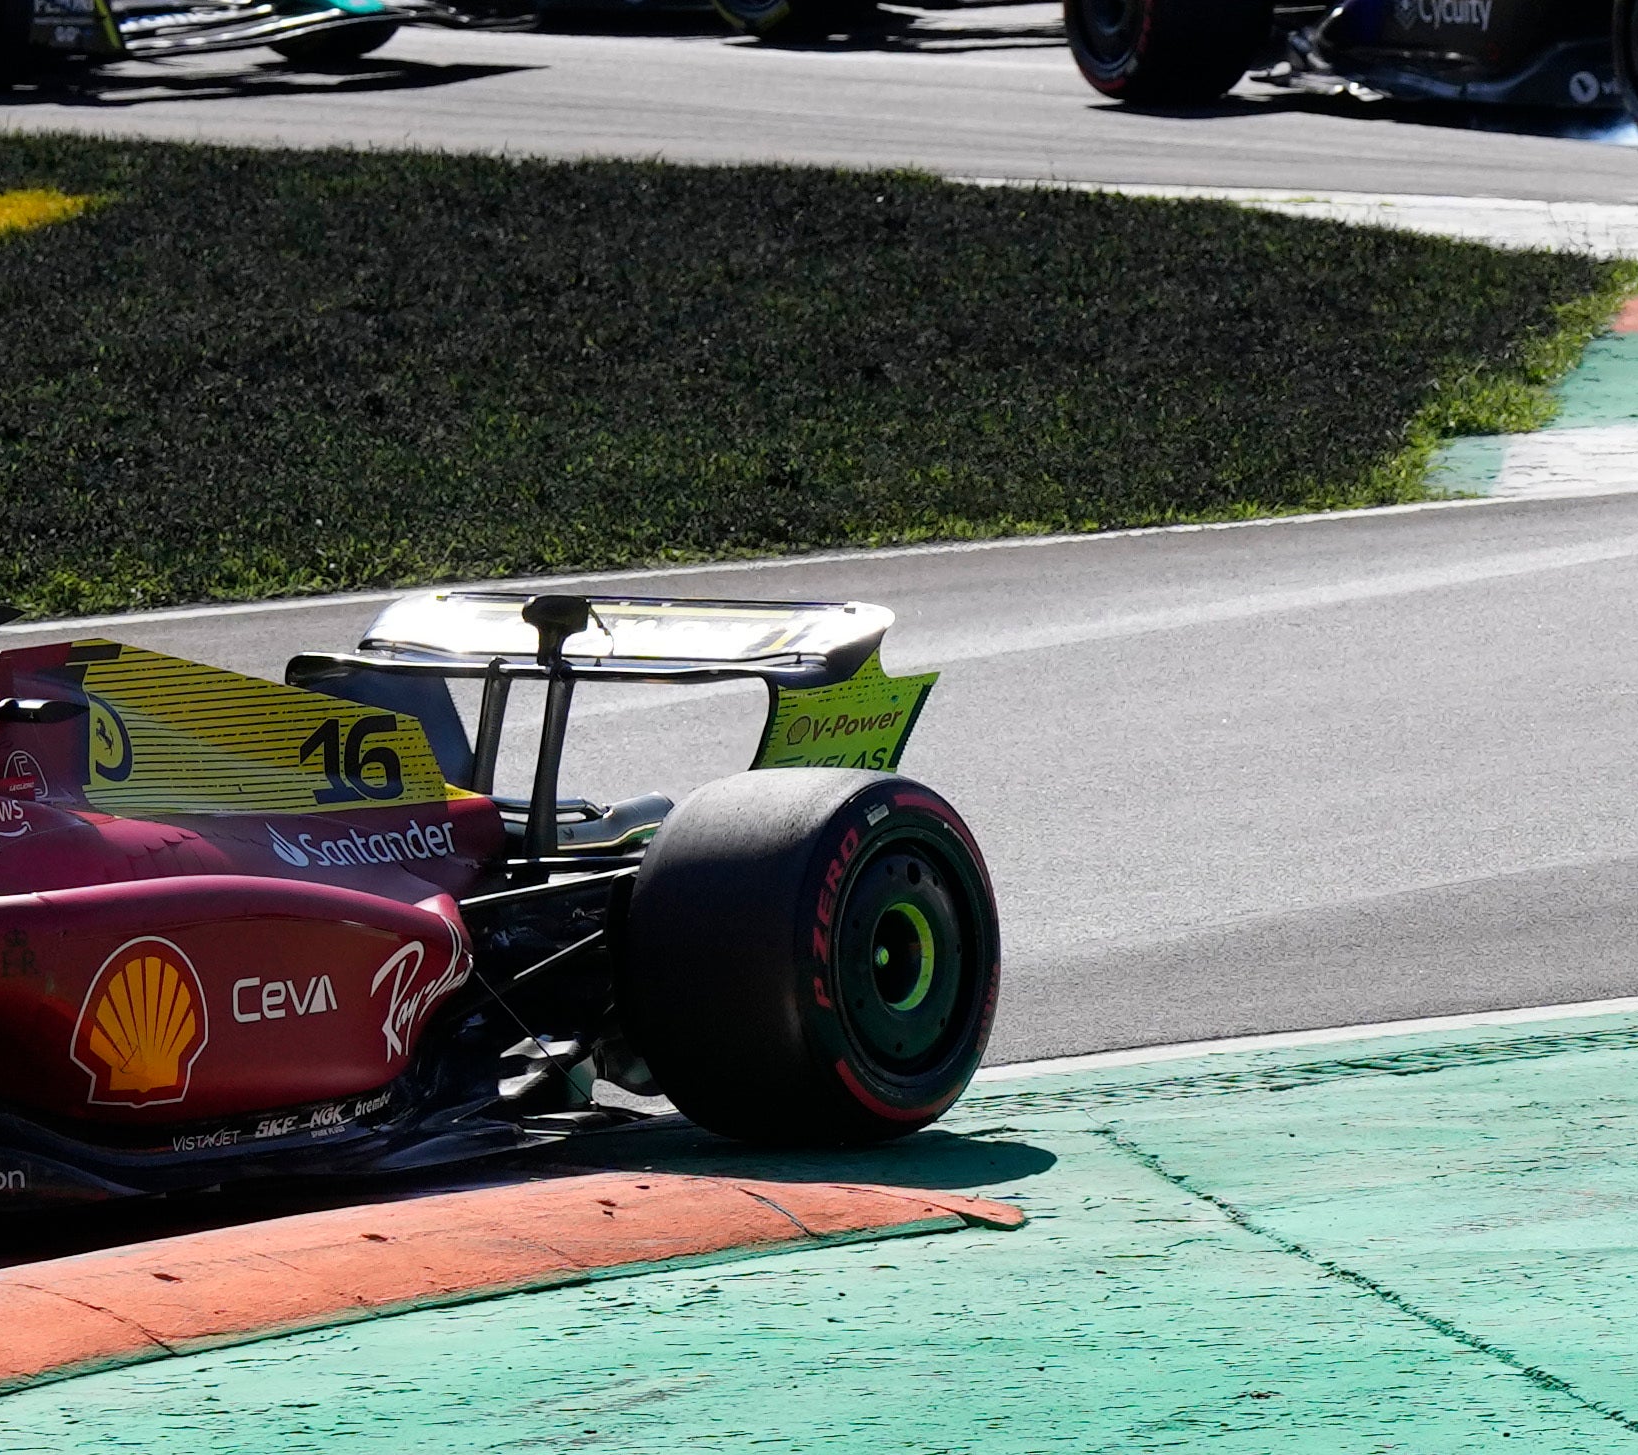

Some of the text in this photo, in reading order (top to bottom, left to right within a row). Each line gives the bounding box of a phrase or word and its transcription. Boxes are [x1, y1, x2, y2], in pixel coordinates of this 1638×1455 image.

[811, 708, 904, 743] V-Power
[298, 712, 405, 806] 16
[304, 819, 456, 868] Santander
[811, 827, 861, 1010] P ZERO
[309, 1103, 348, 1129] NGK
